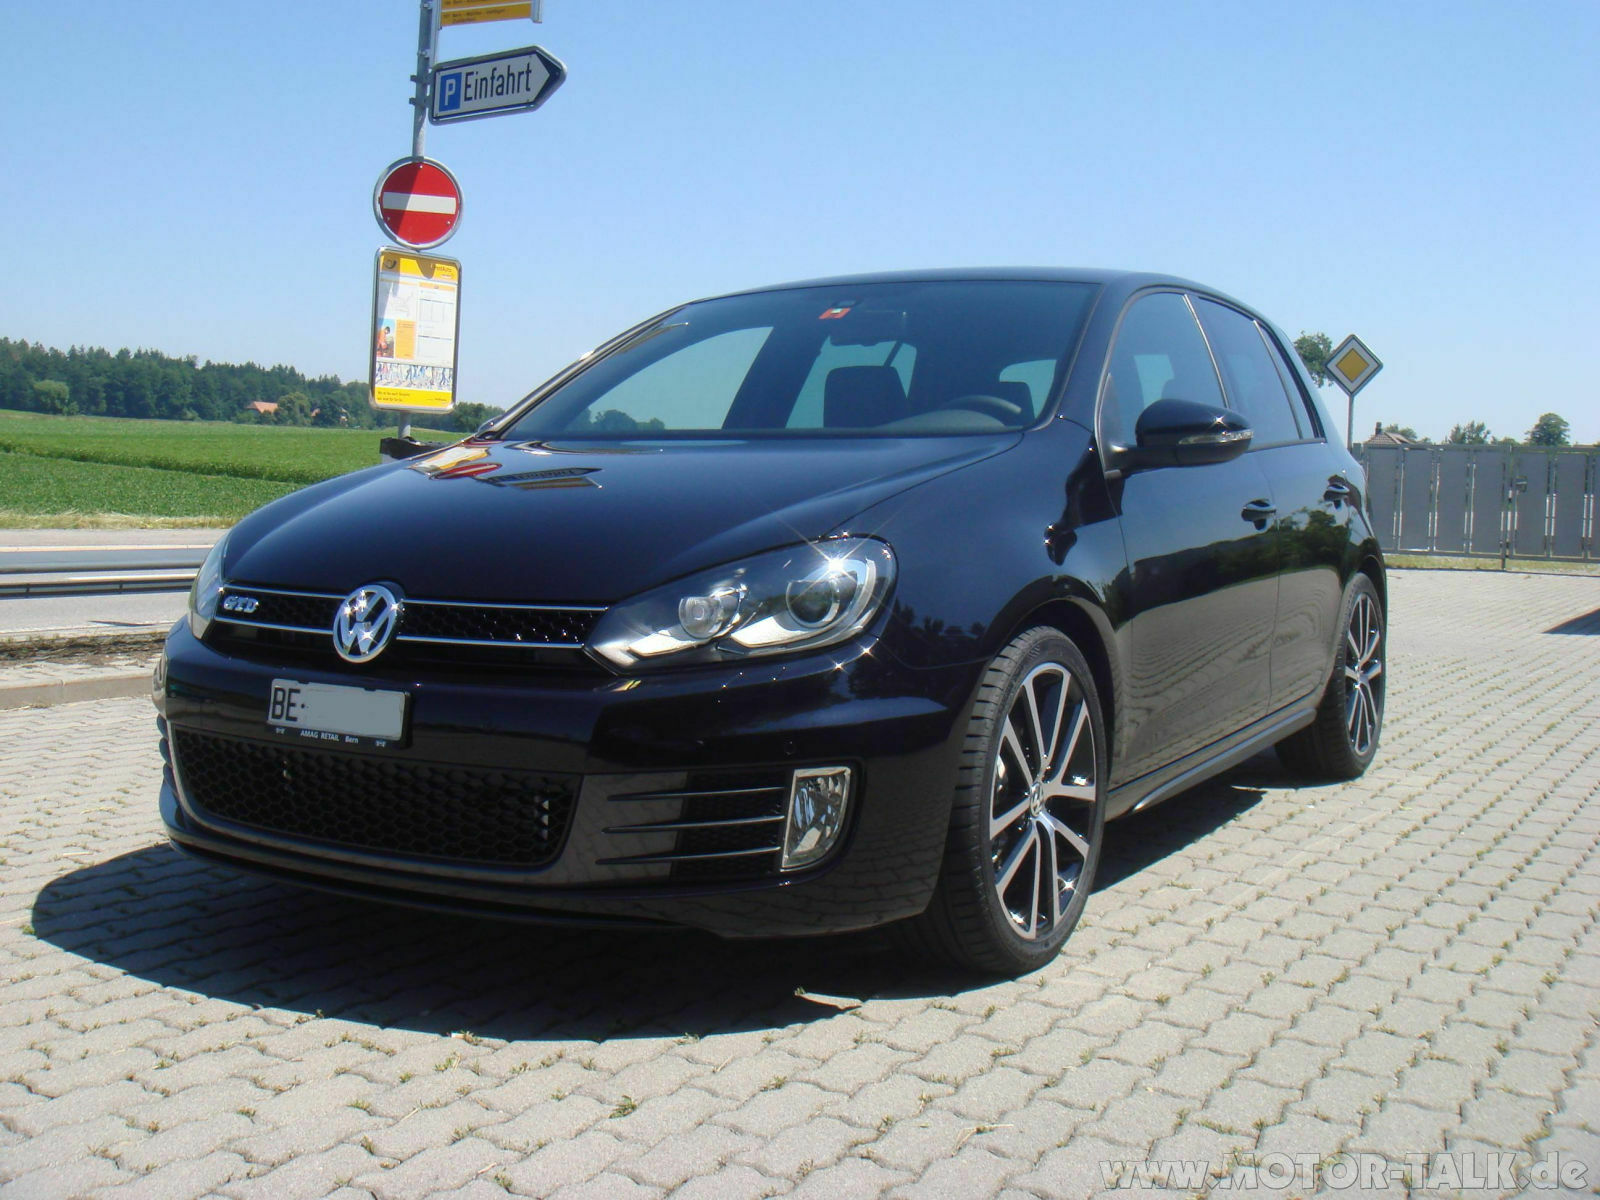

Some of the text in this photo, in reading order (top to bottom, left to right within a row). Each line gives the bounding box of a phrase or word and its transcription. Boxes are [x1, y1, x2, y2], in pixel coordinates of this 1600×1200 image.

[444, 62, 532, 107] P Einfahrt
[223, 595, 259, 613] GTD
[300, 729, 359, 744] AMAG RETAIL Bern
